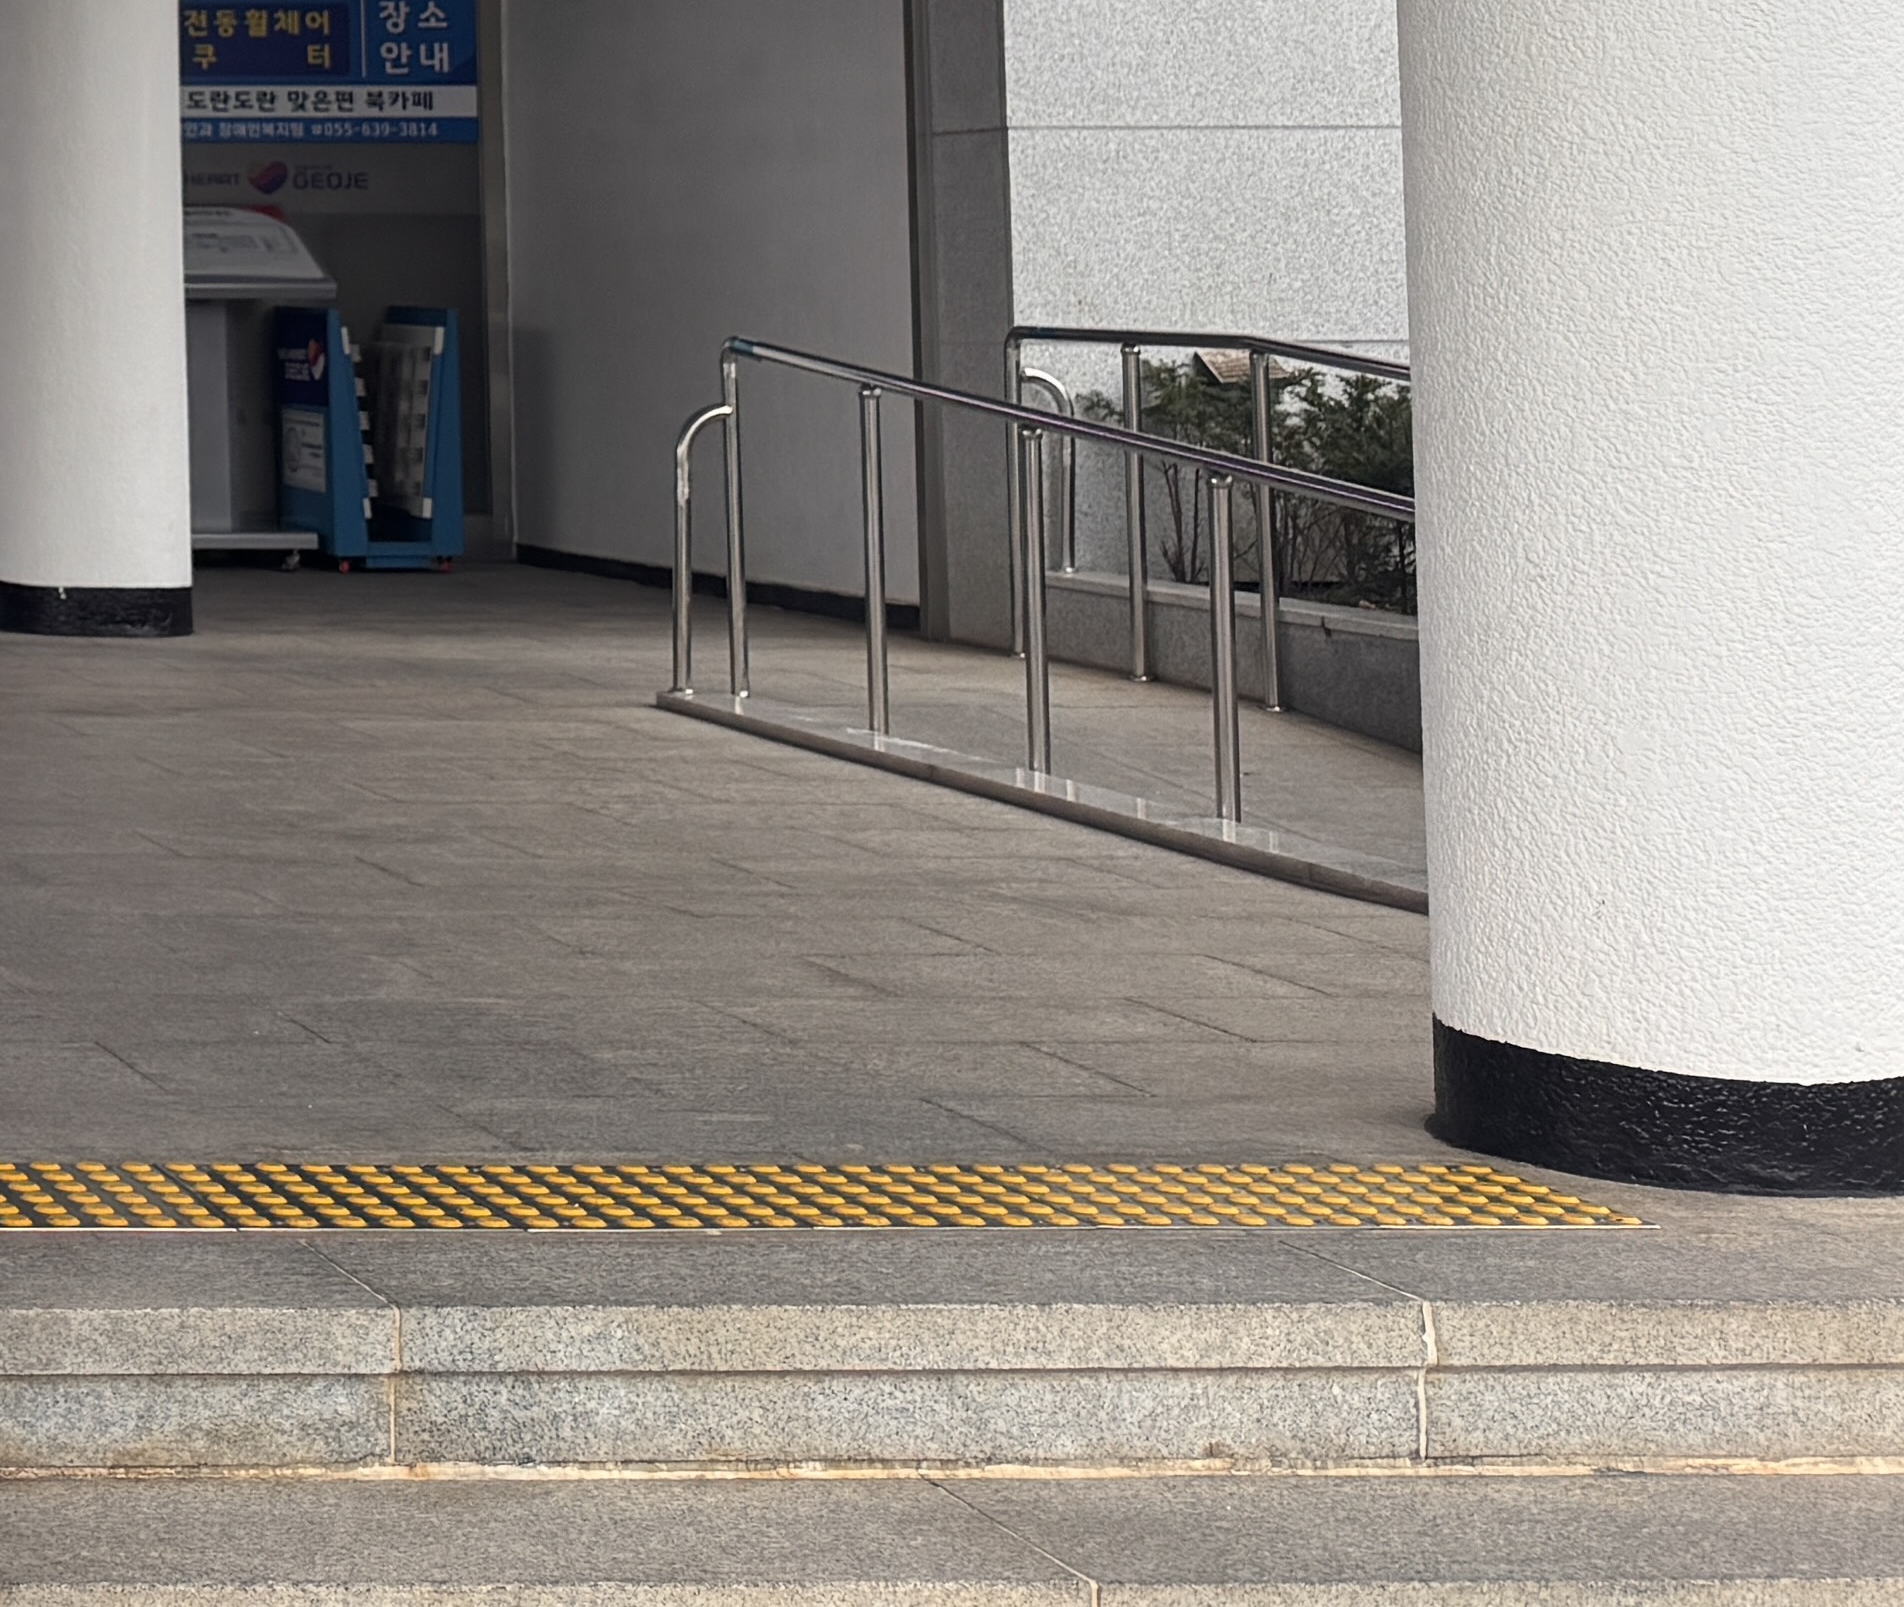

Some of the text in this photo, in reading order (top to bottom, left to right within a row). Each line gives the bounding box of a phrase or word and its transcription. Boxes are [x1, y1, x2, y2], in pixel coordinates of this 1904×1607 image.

[184, 8, 331, 38] 전동휠체어
[379, 0, 448, 34] 장소
[380, 41, 450, 74] 안내
[186, 90, 277, 113] 도란도란
[287, 90, 354, 113] 맞은편
[293, 171, 368, 190] GEOJE
